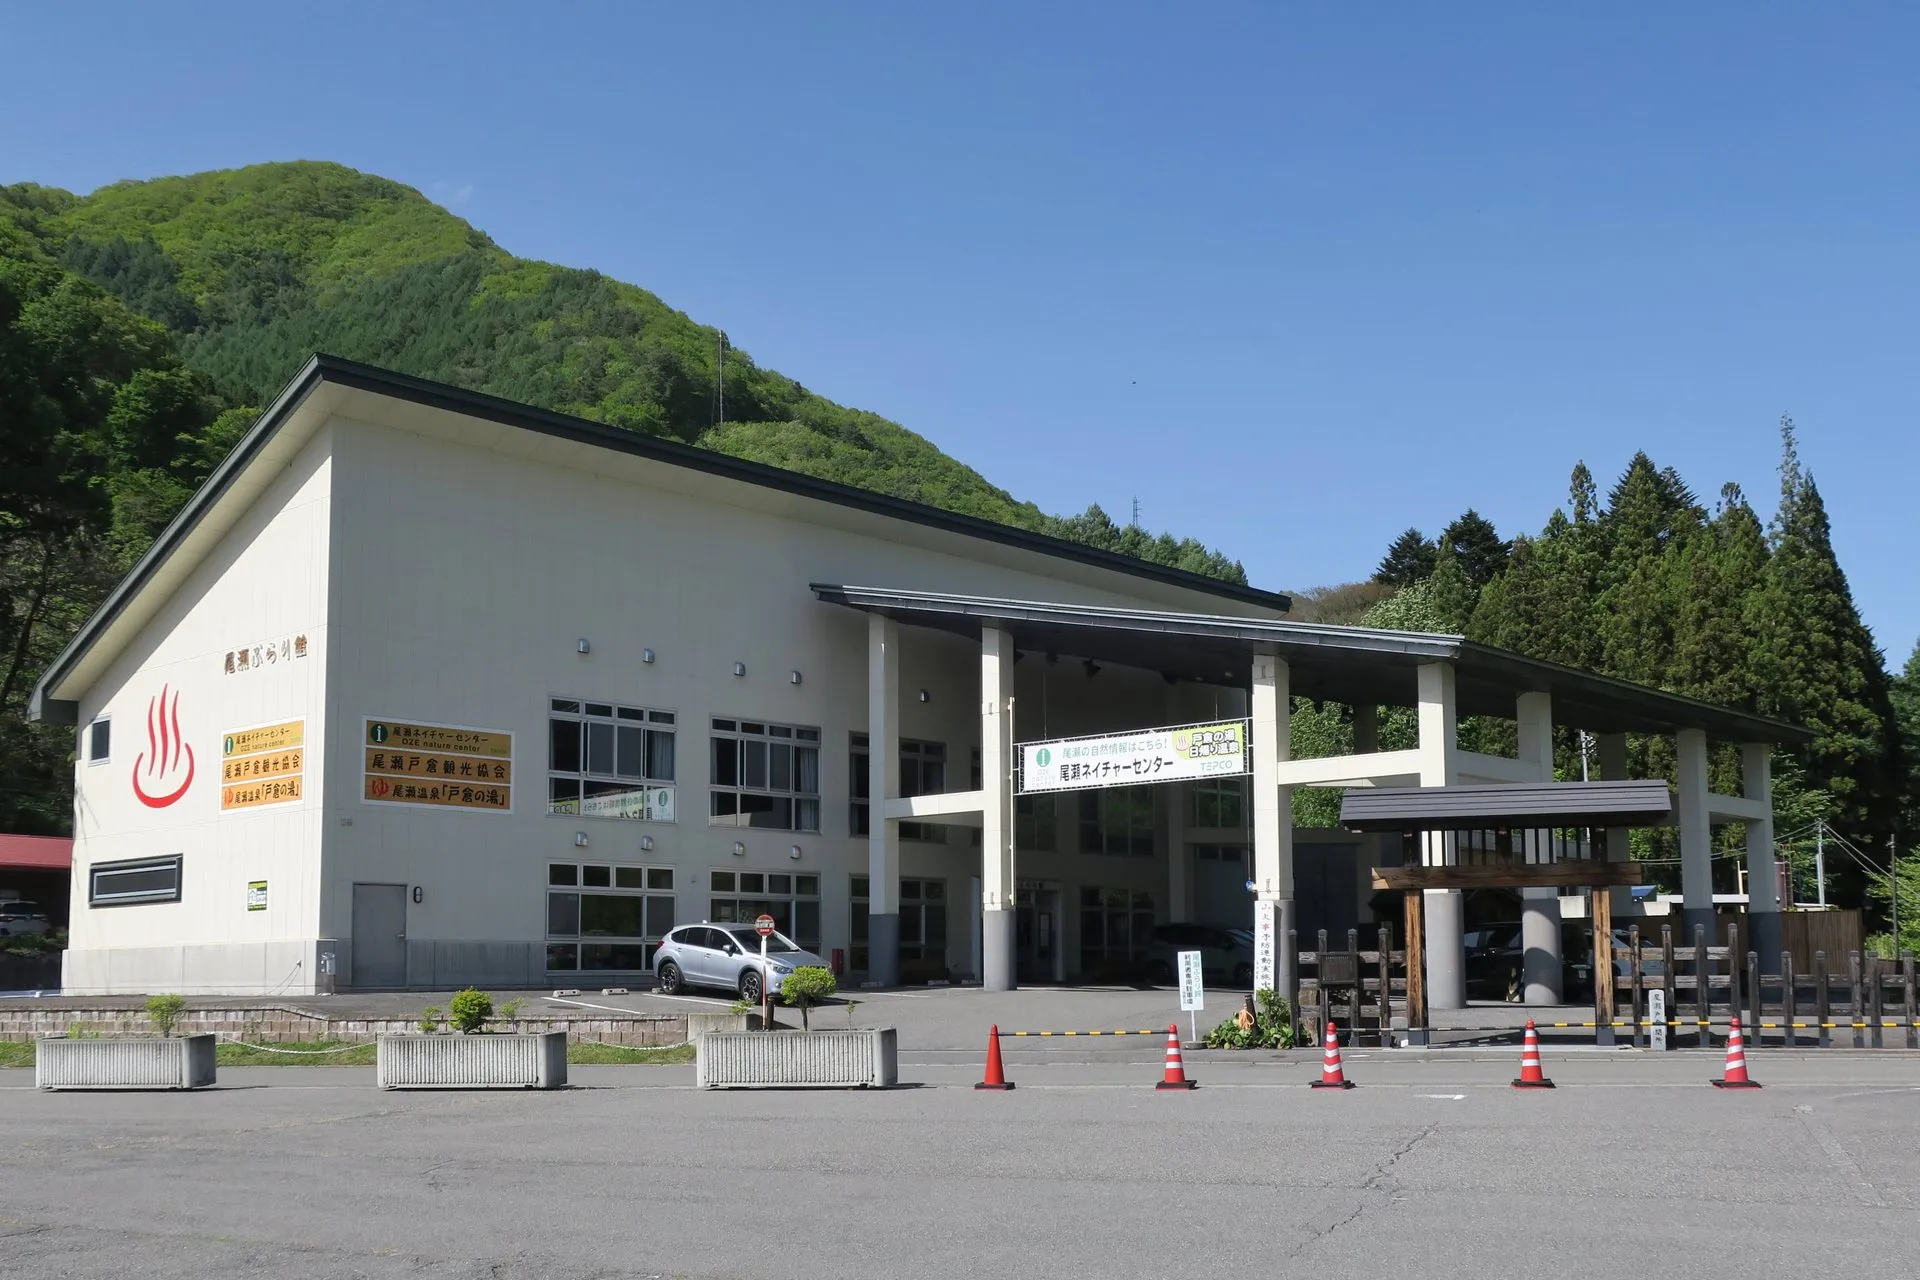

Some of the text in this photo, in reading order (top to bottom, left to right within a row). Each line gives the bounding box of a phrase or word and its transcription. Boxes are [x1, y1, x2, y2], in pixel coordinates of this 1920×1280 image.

[235, 728, 290, 745] 尾瀬ネイチャーセンター
[392, 727, 489, 743] 尾瀬ネイチャーセンター
[1192, 728, 1236, 746] 戸倉の湯
[402, 738, 420, 747] OZE
[423, 741, 451, 750] nature
[454, 744, 481, 753] center
[1189, 741, 1240, 758] 日帰り温泉
[224, 754, 300, 779] 尾瀬戸倉観光協会
[372, 753, 505, 779] 尾瀬戸倉観光協会
[1060, 755, 1174, 781] 尾瀬ネイチャーセンター
[1200, 760, 1233, 771] TEPCO
